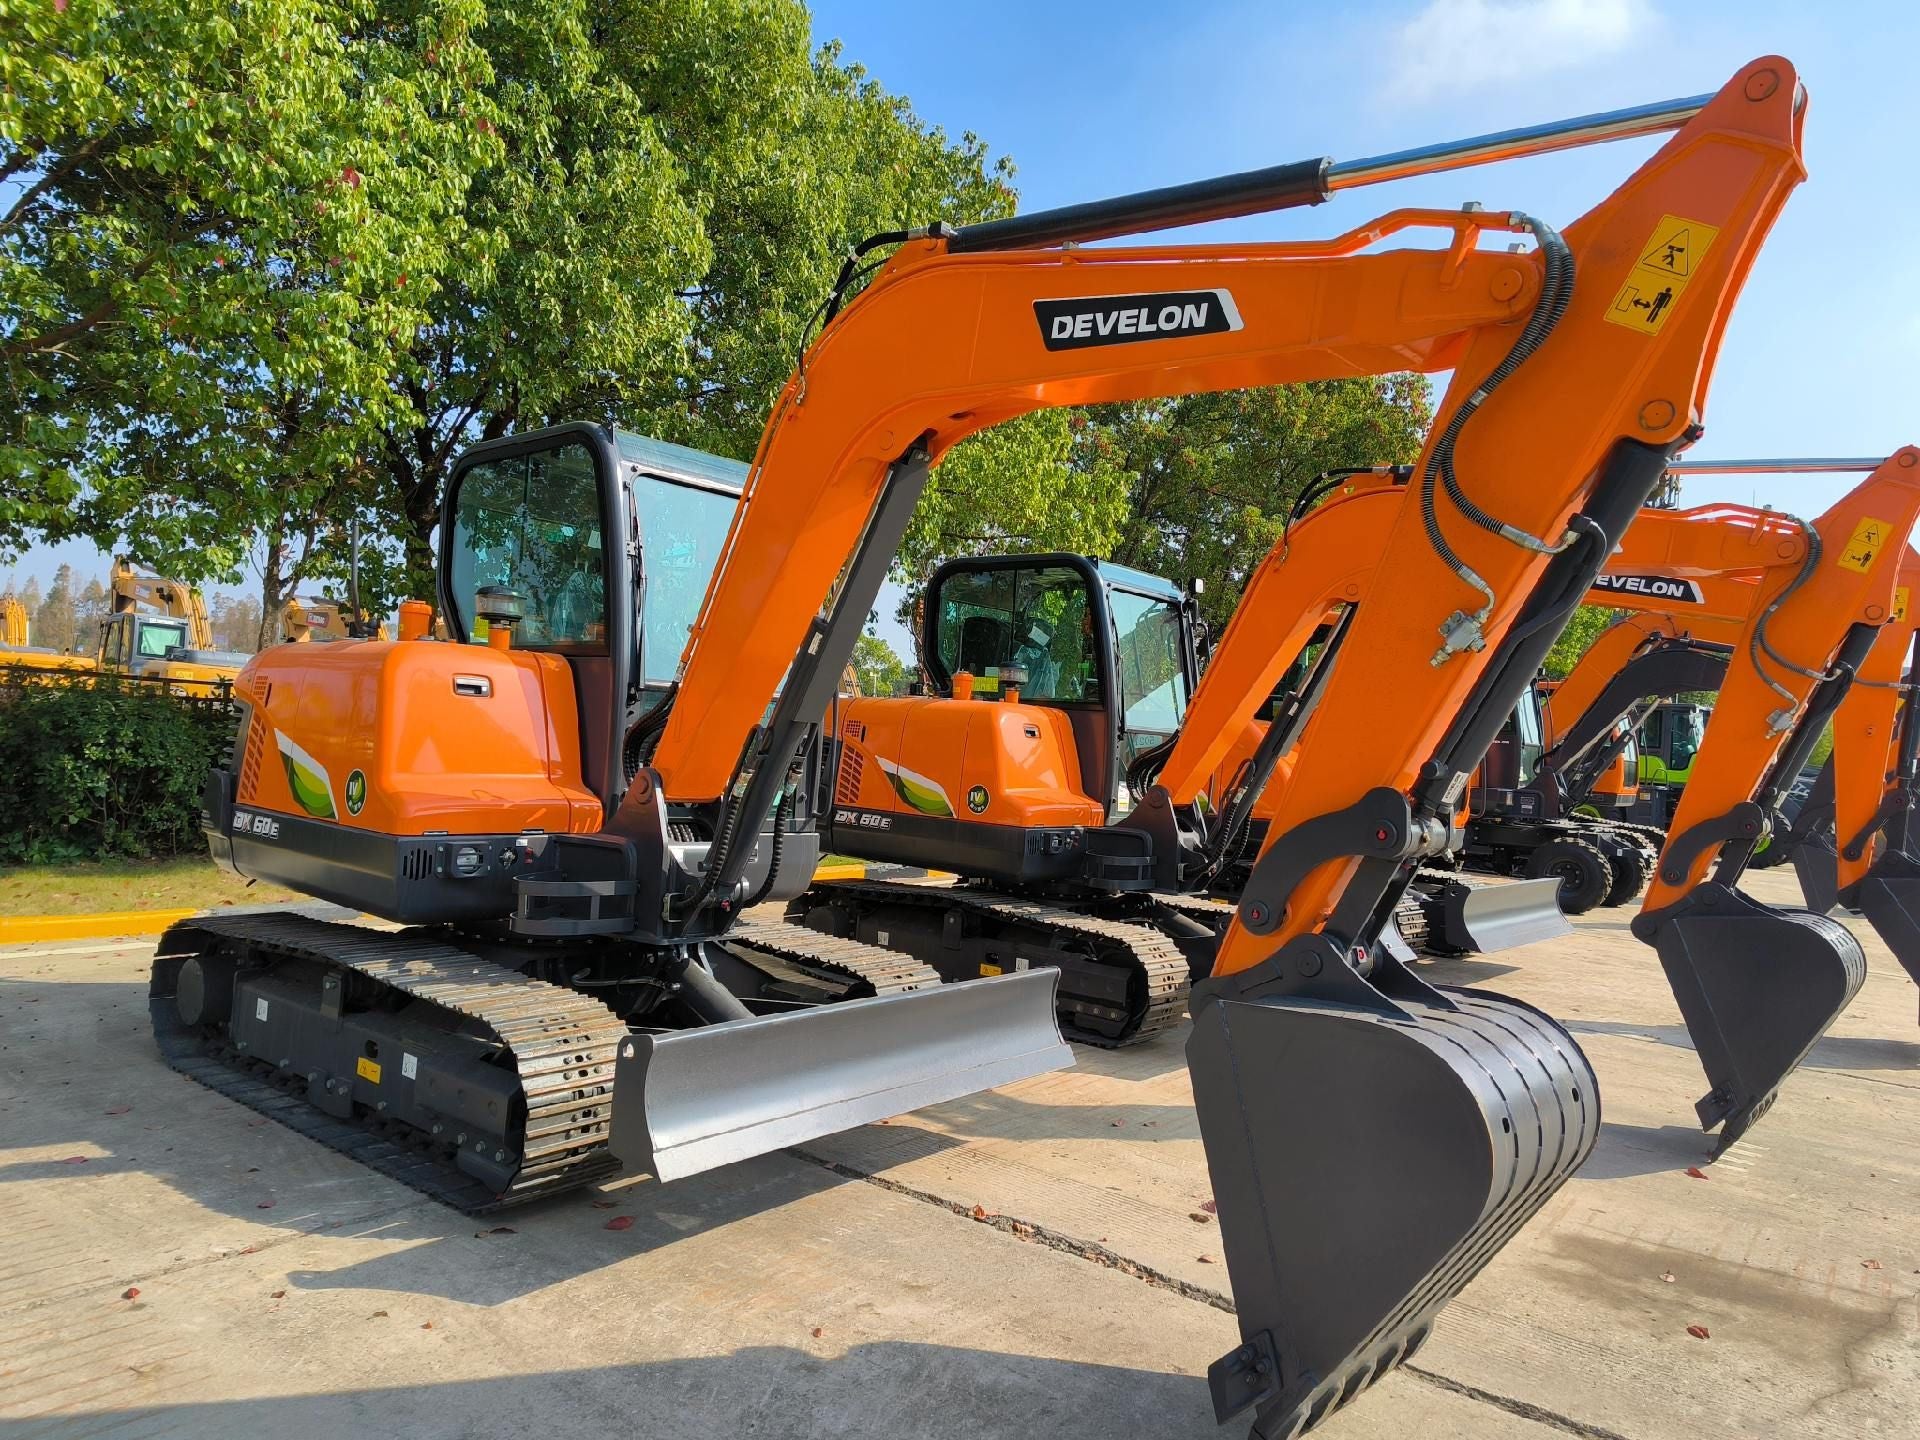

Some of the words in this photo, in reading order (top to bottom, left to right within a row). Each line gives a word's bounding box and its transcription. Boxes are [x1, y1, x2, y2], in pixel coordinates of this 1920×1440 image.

[1051, 303, 1208, 339] DEVELON
[1595, 574, 1684, 597] EVELON
[233, 811, 252, 833] DX
[834, 810, 858, 826] DX
